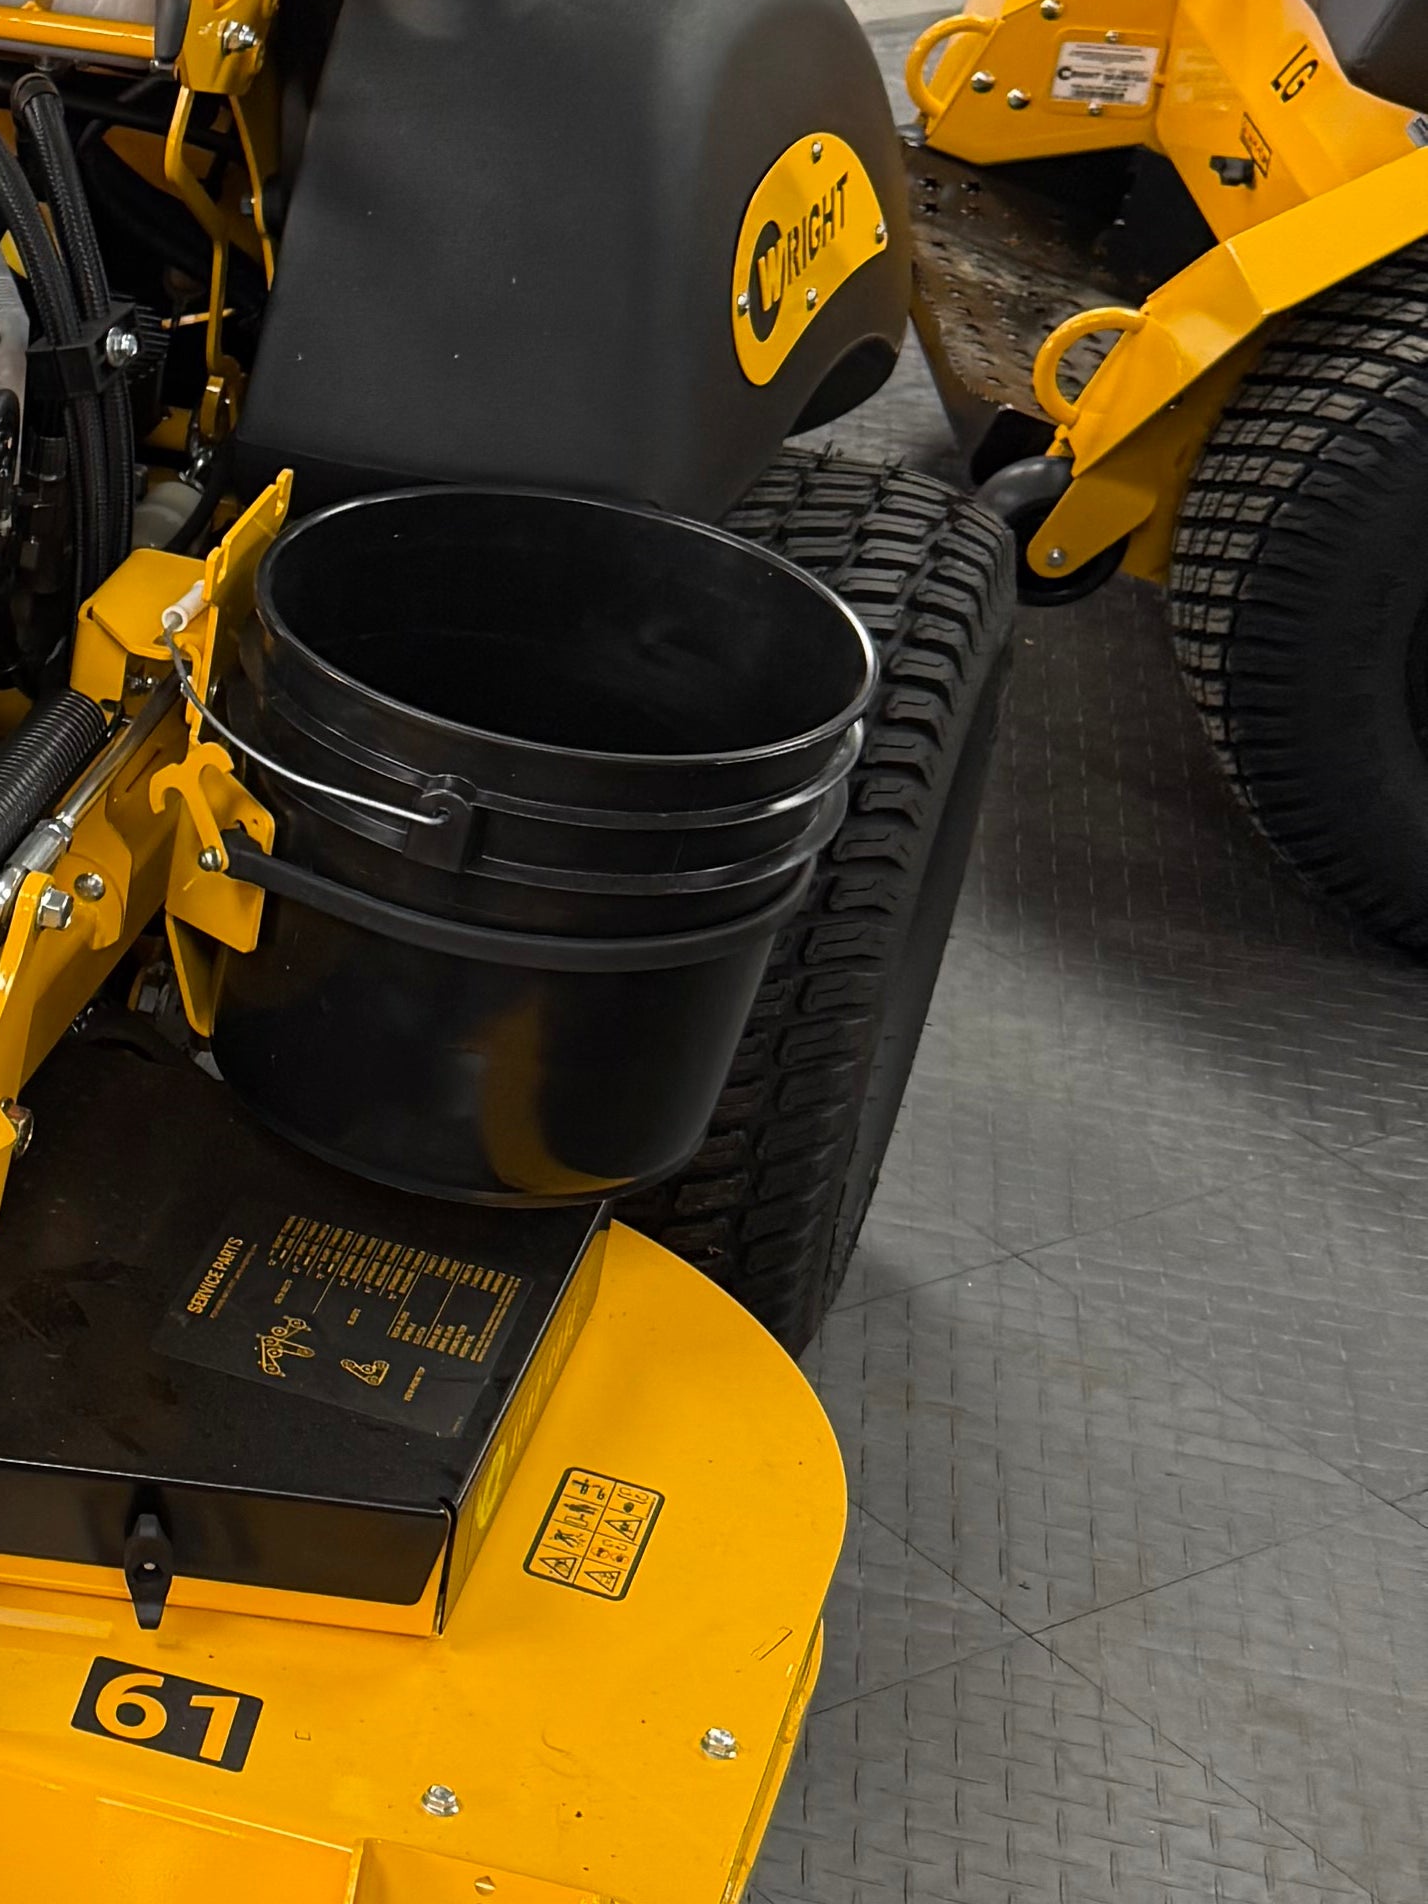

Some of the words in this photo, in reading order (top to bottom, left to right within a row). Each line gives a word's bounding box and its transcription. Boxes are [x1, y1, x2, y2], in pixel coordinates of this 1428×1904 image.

[748, 169, 848, 343] WRIGHT
[187, 1269, 224, 1314] SERVICE
[212, 1236, 244, 1270] PARTS
[95, 1672, 240, 1762] 61
